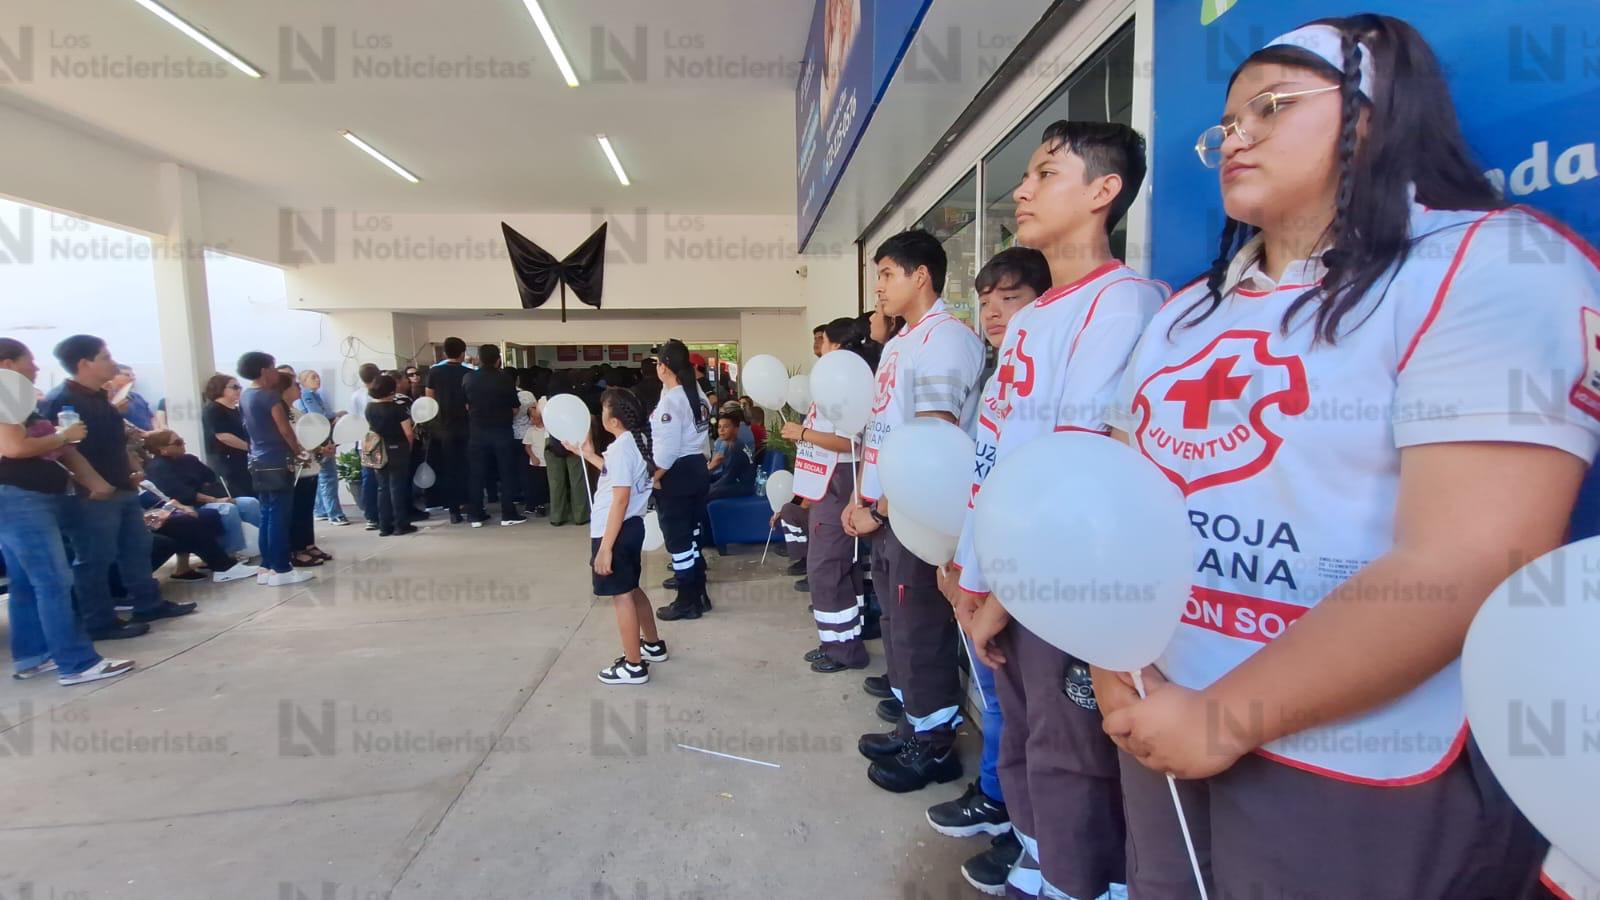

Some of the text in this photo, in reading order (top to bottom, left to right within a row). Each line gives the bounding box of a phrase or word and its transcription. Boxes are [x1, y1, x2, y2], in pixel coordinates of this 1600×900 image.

[1148, 423, 1251, 461] JUVENTUD
[1188, 509, 1301, 553] ROJA
[1234, 607, 1297, 639] SO
